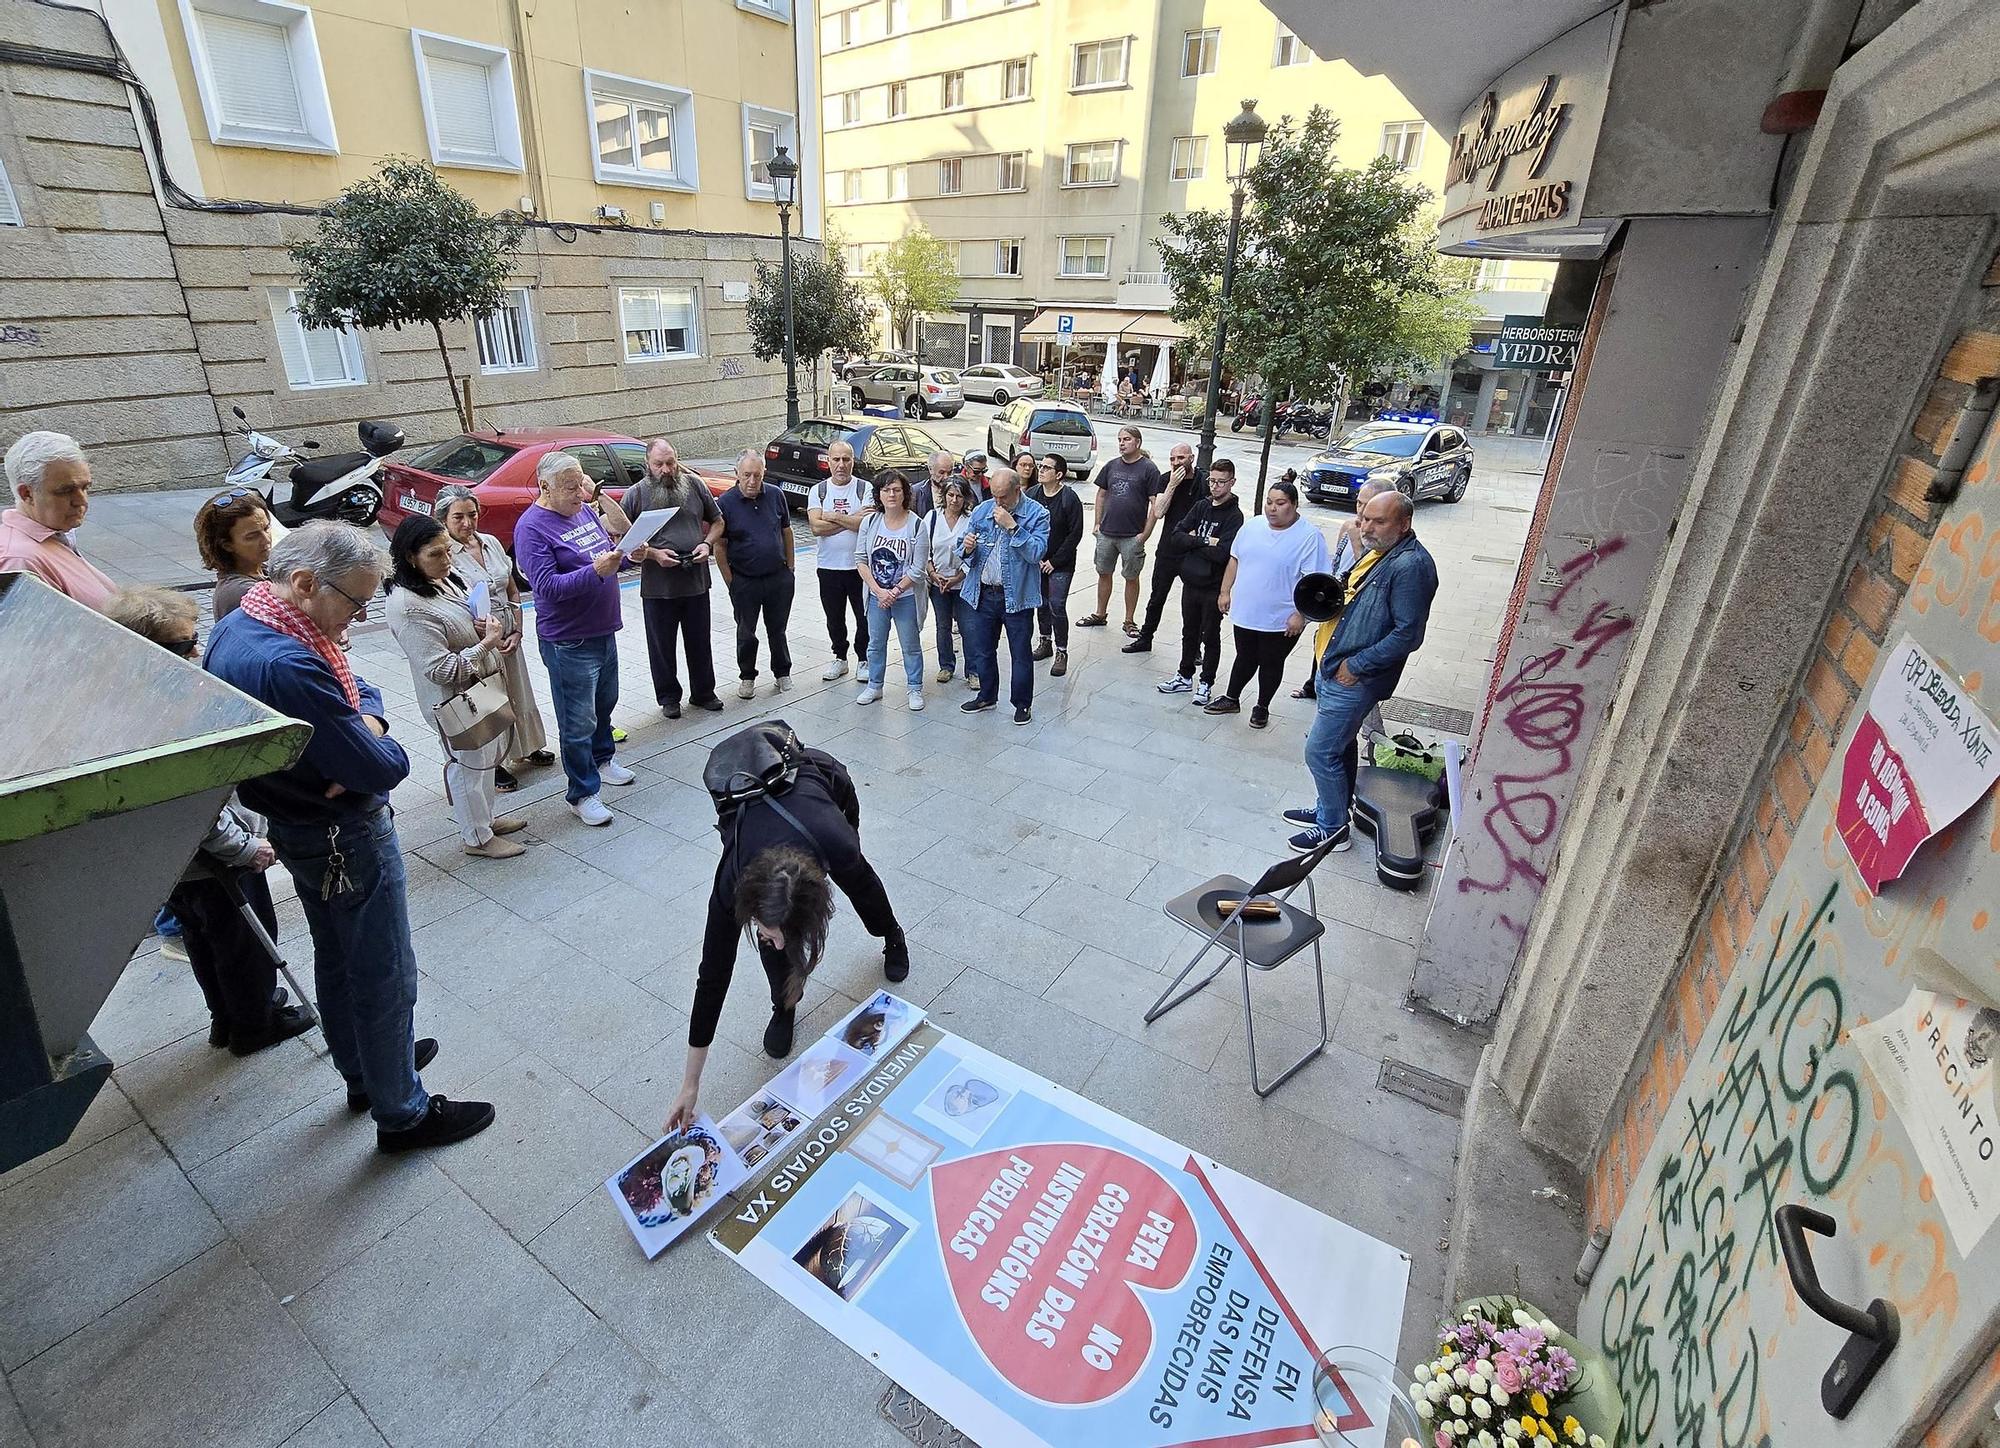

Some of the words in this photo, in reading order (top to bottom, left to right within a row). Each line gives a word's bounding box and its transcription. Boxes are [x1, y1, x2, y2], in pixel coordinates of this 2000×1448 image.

[1475, 181, 1571, 230] ZAPATERIAS
[1499, 343, 1577, 365] YEDRA
[1959, 716, 1993, 769] XUNTA
[844, 1042, 925, 1118] VIVENDAS
[1923, 1010, 1993, 1161] PRECINTO
[771, 1116, 850, 1193] SOCIAIS
[735, 1189, 778, 1224] XA
[950, 1155, 1034, 1262] PÚBLICAS
[980, 1162, 1086, 1312] INSTITUCIÓNS
[1055, 1182, 1131, 1291] CORAZÓN
[1125, 1210, 1175, 1271] PETA
[1025, 1285, 1074, 1350] DAS
[1149, 1242, 1233, 1430] EMPOBRECIDAS
[1217, 1289, 1250, 1338] DAS
[1080, 1323, 1123, 1371] NO
[1196, 1338, 1233, 1404] NAIS
[1227, 1305, 1279, 1422] DEFENSA
[1273, 1360, 1301, 1403] EN
